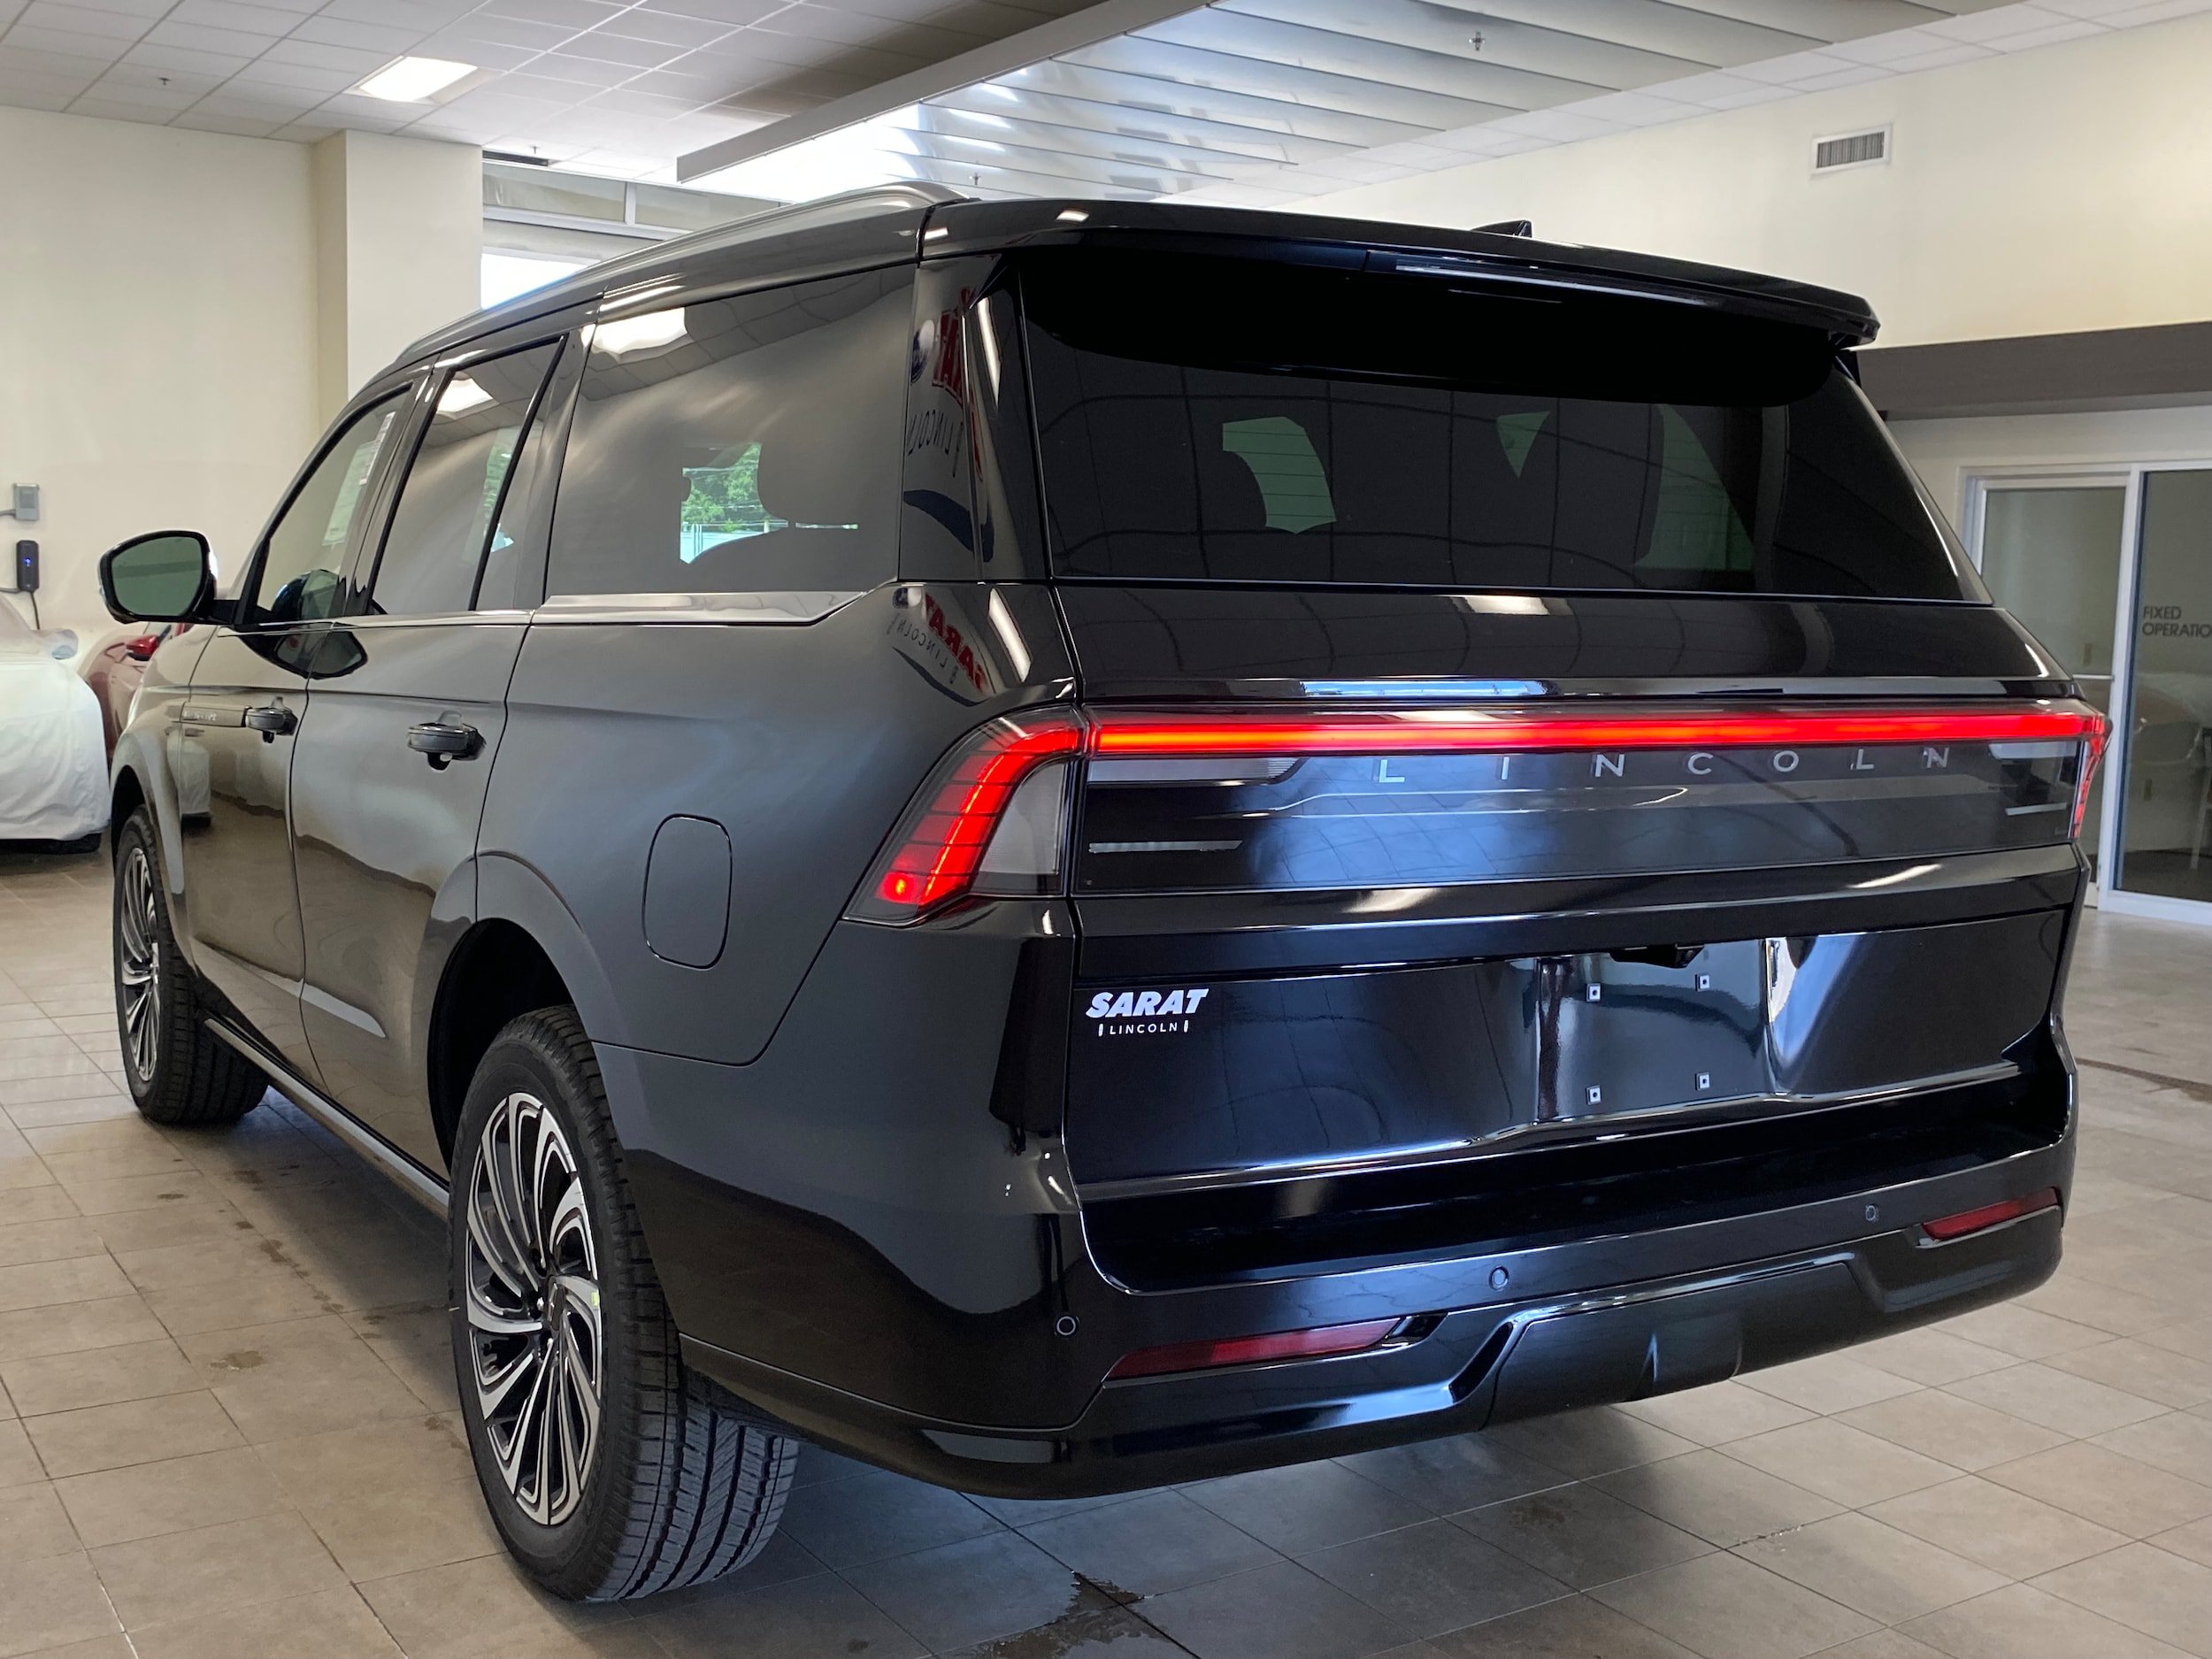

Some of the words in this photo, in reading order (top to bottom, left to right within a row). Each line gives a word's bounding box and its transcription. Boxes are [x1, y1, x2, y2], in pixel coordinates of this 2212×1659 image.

[2143, 605, 2182, 619] FIXED
[1379, 747, 1950, 783] LINCOLN
[1086, 988, 1209, 1018] SARAT
[1110, 1022, 1178, 1035] LINCOLN
